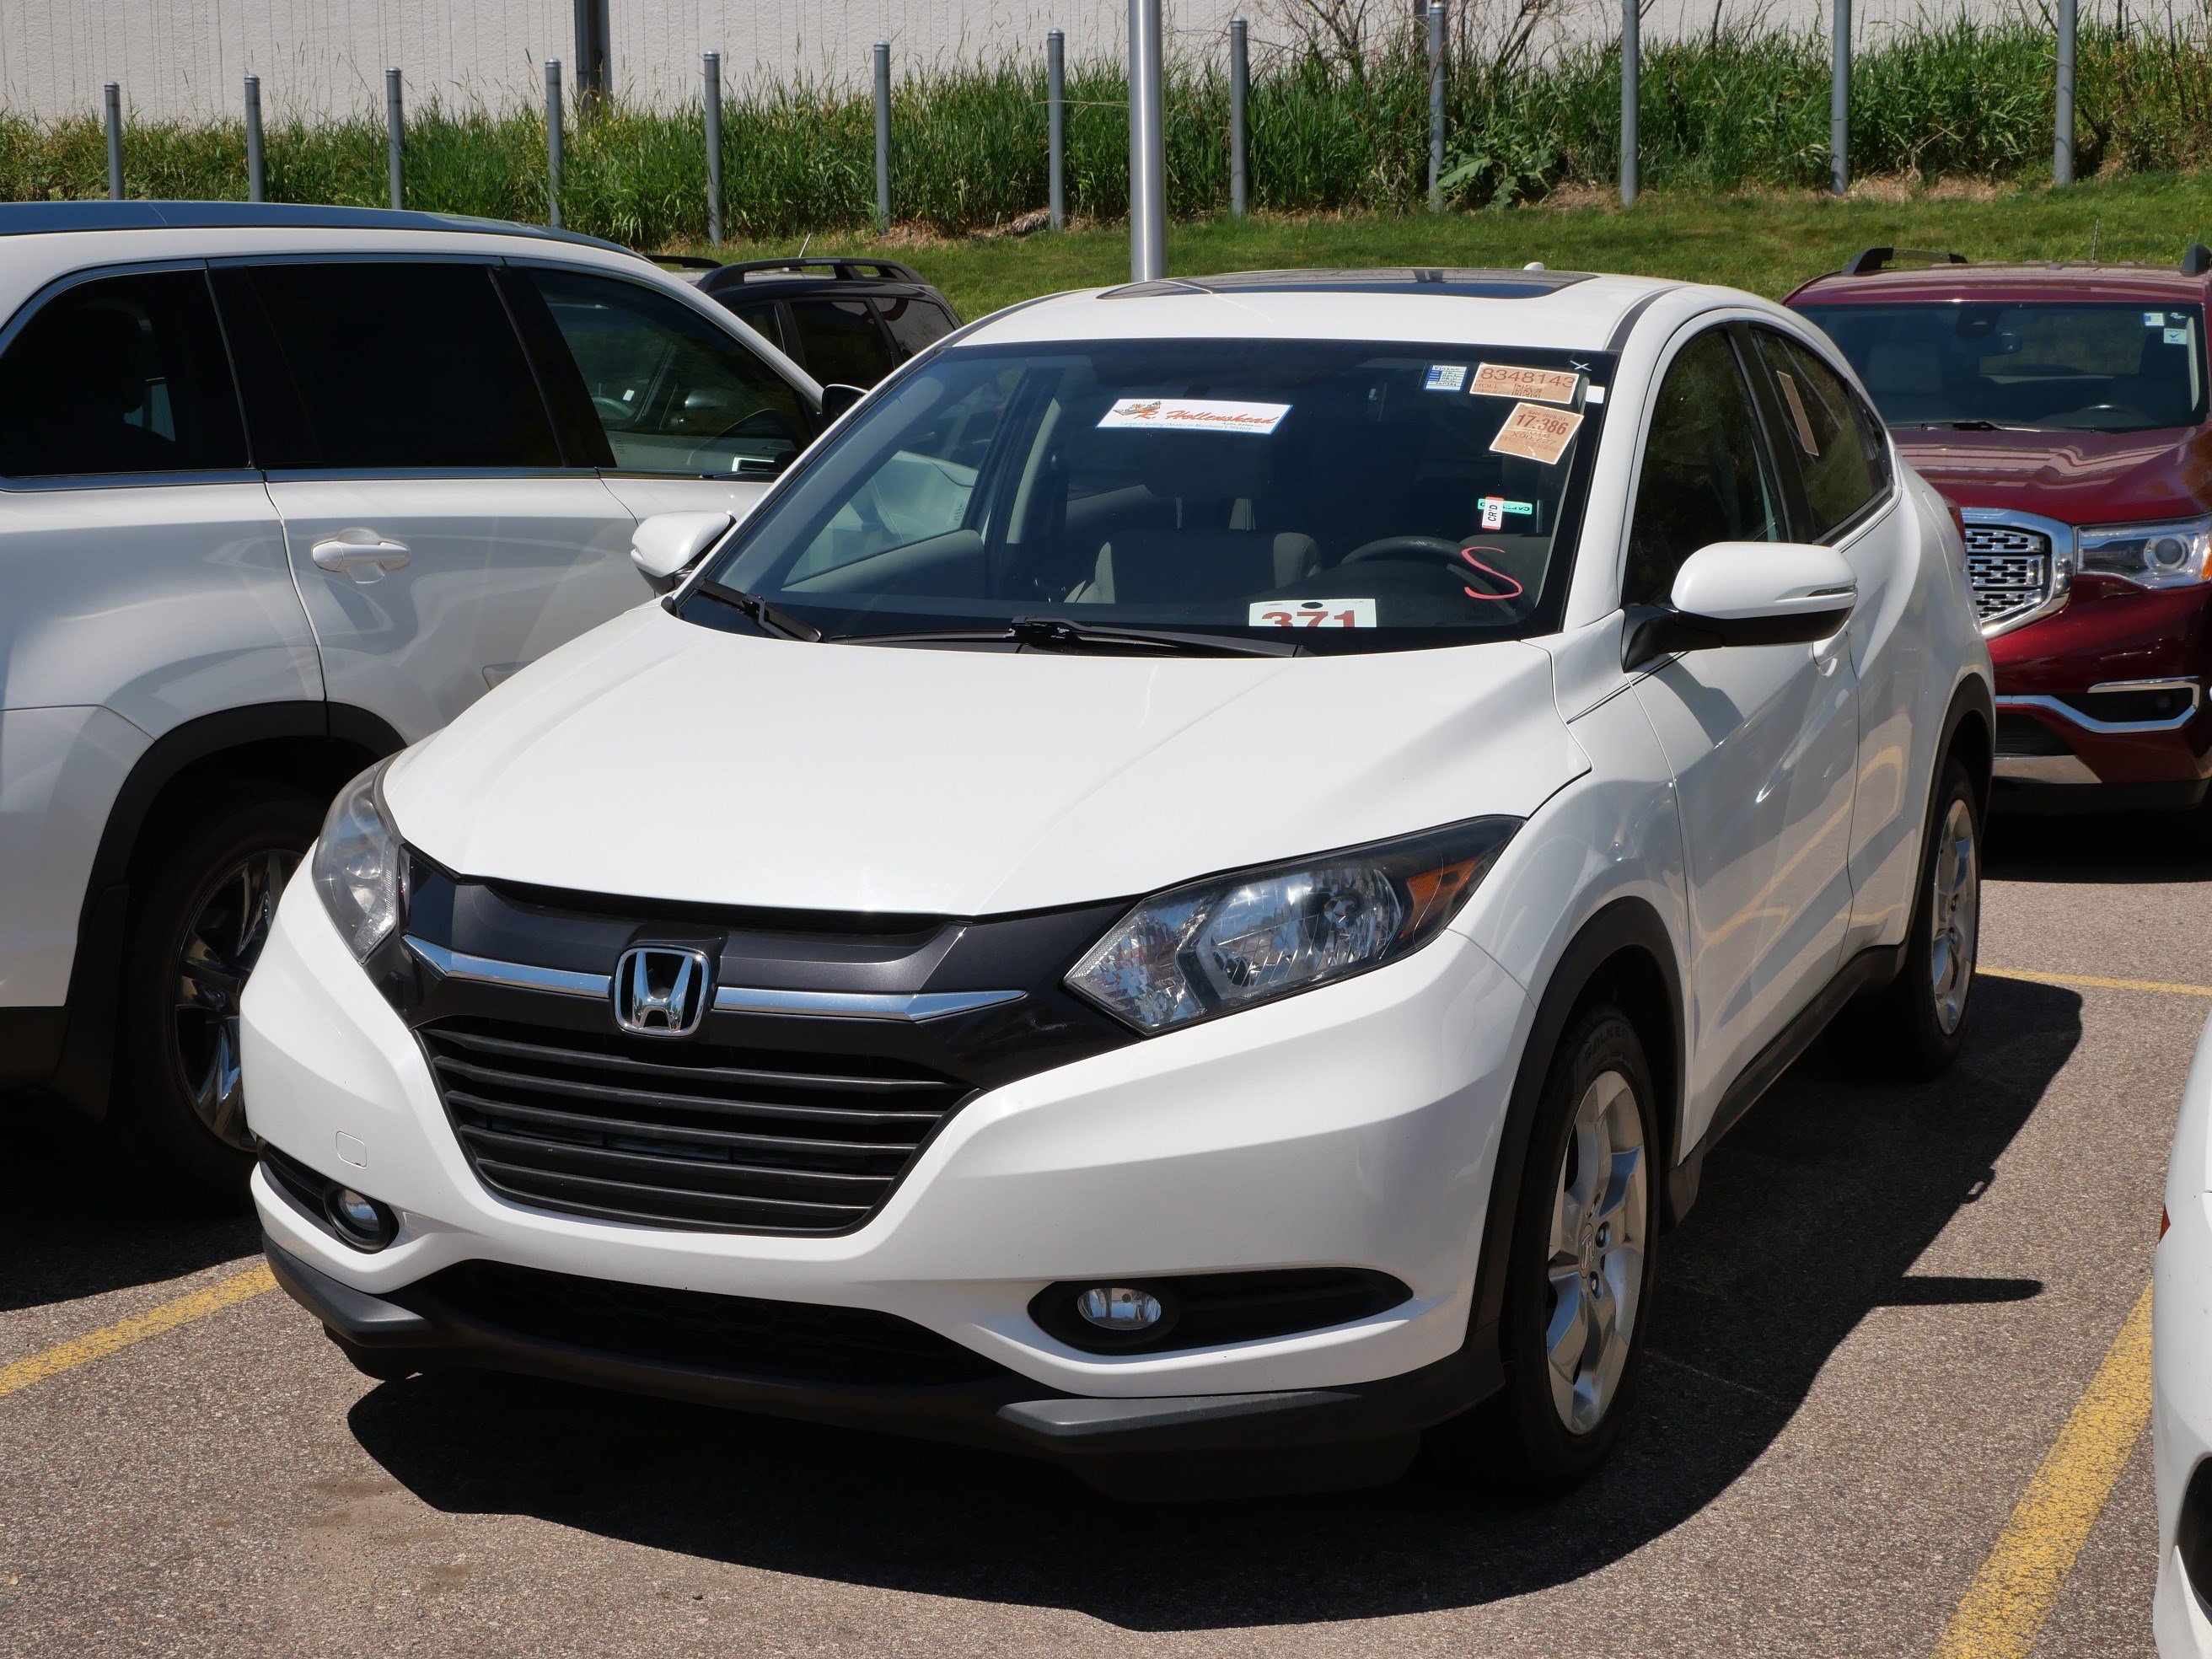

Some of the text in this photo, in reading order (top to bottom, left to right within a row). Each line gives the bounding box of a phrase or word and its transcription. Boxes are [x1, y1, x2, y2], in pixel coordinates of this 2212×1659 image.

[1480, 368, 1576, 388] 8348143
[1165, 410, 1280, 424] Hollenshead
[1517, 414, 1569, 435] 17:386
[1261, 609, 1356, 627] 371
